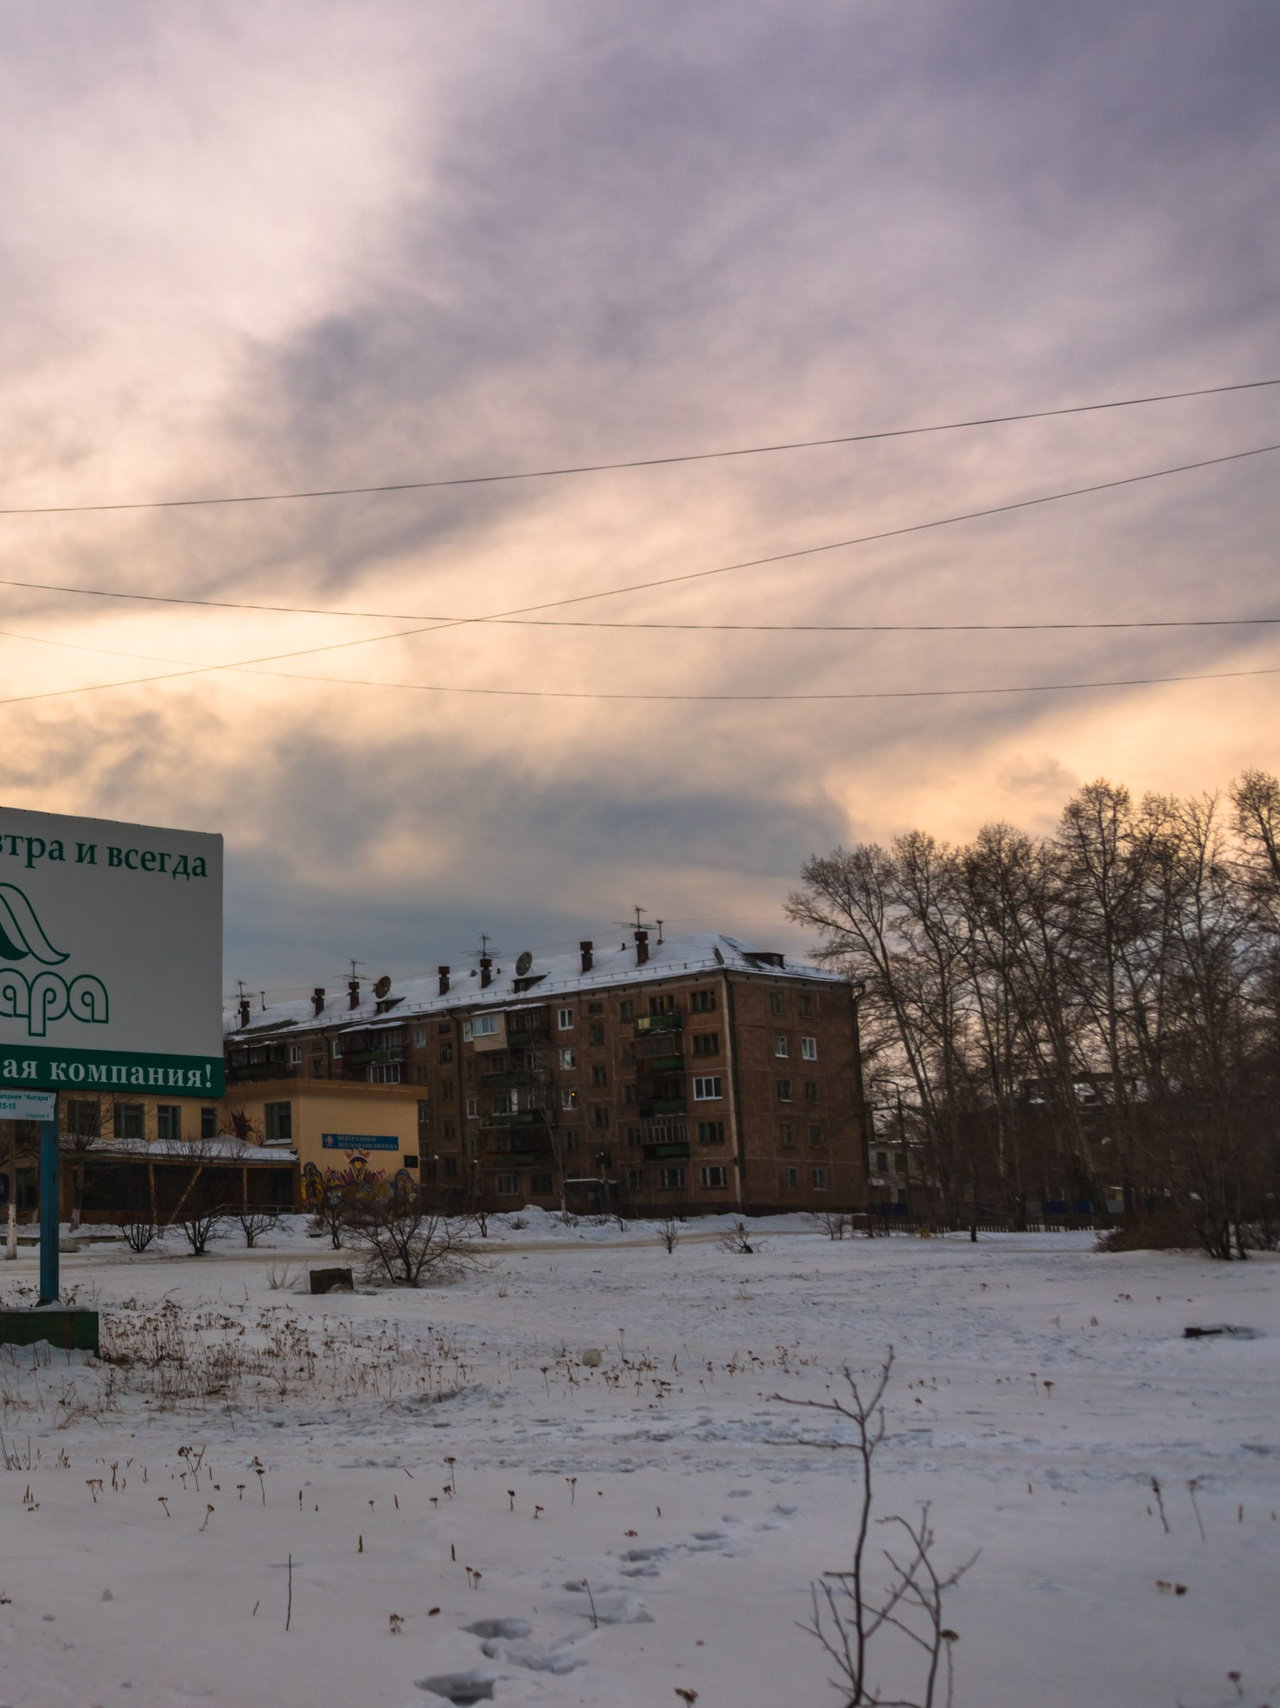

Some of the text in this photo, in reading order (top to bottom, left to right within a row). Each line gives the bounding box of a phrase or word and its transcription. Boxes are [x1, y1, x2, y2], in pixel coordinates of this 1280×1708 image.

[75, 842, 98, 865] и
[106, 846, 208, 881] всегда
[49, 1061, 213, 1090] компания!
[24, 1094, 52, 1102] "Ангара"
